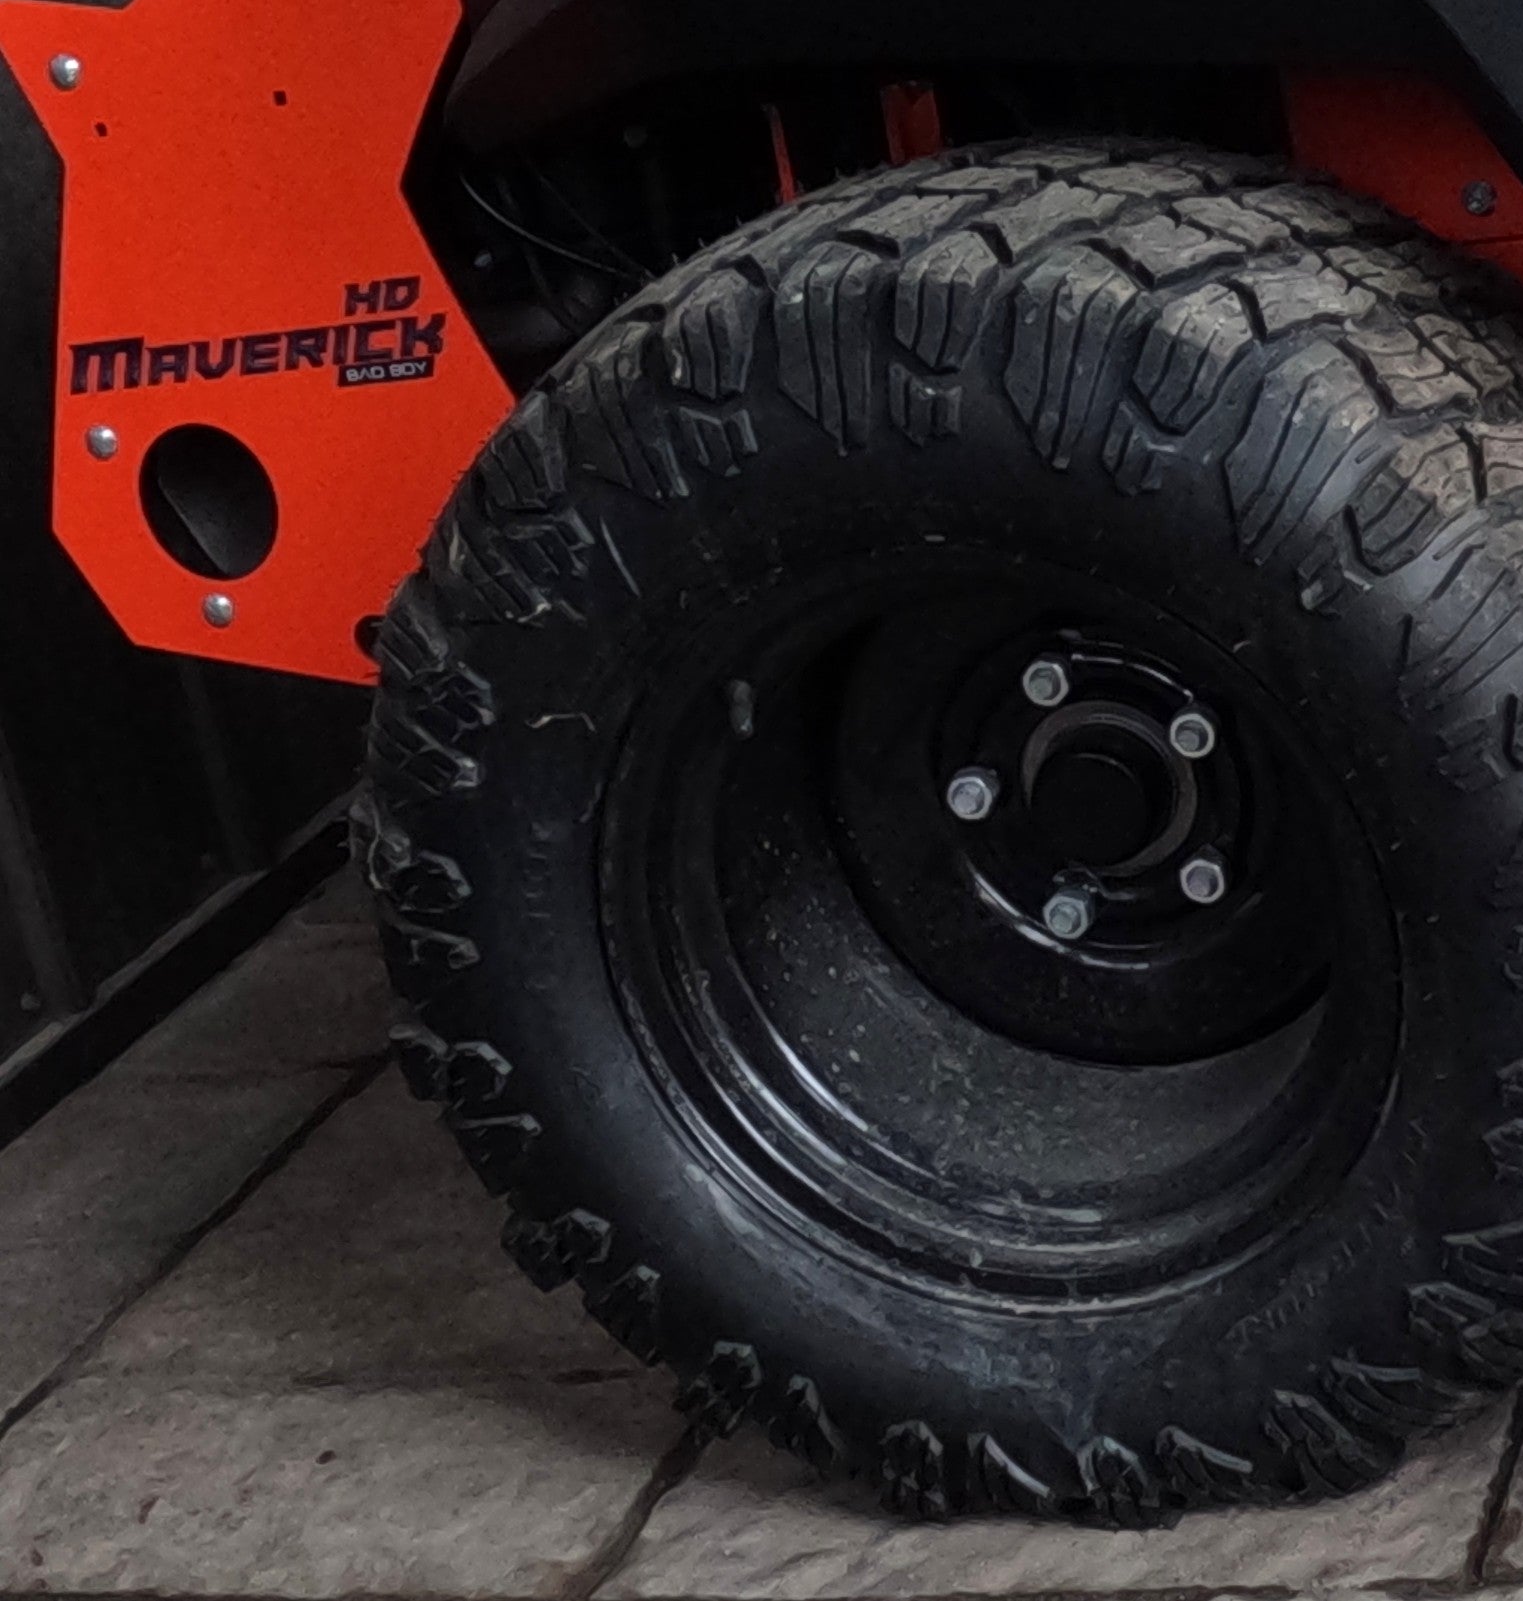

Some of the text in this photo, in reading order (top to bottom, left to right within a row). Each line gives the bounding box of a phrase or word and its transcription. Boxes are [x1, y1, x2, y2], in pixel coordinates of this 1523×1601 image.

[344, 276, 421, 316] HD
[69, 312, 447, 396] MAVERICK
[345, 360, 428, 383] BAD BOY
